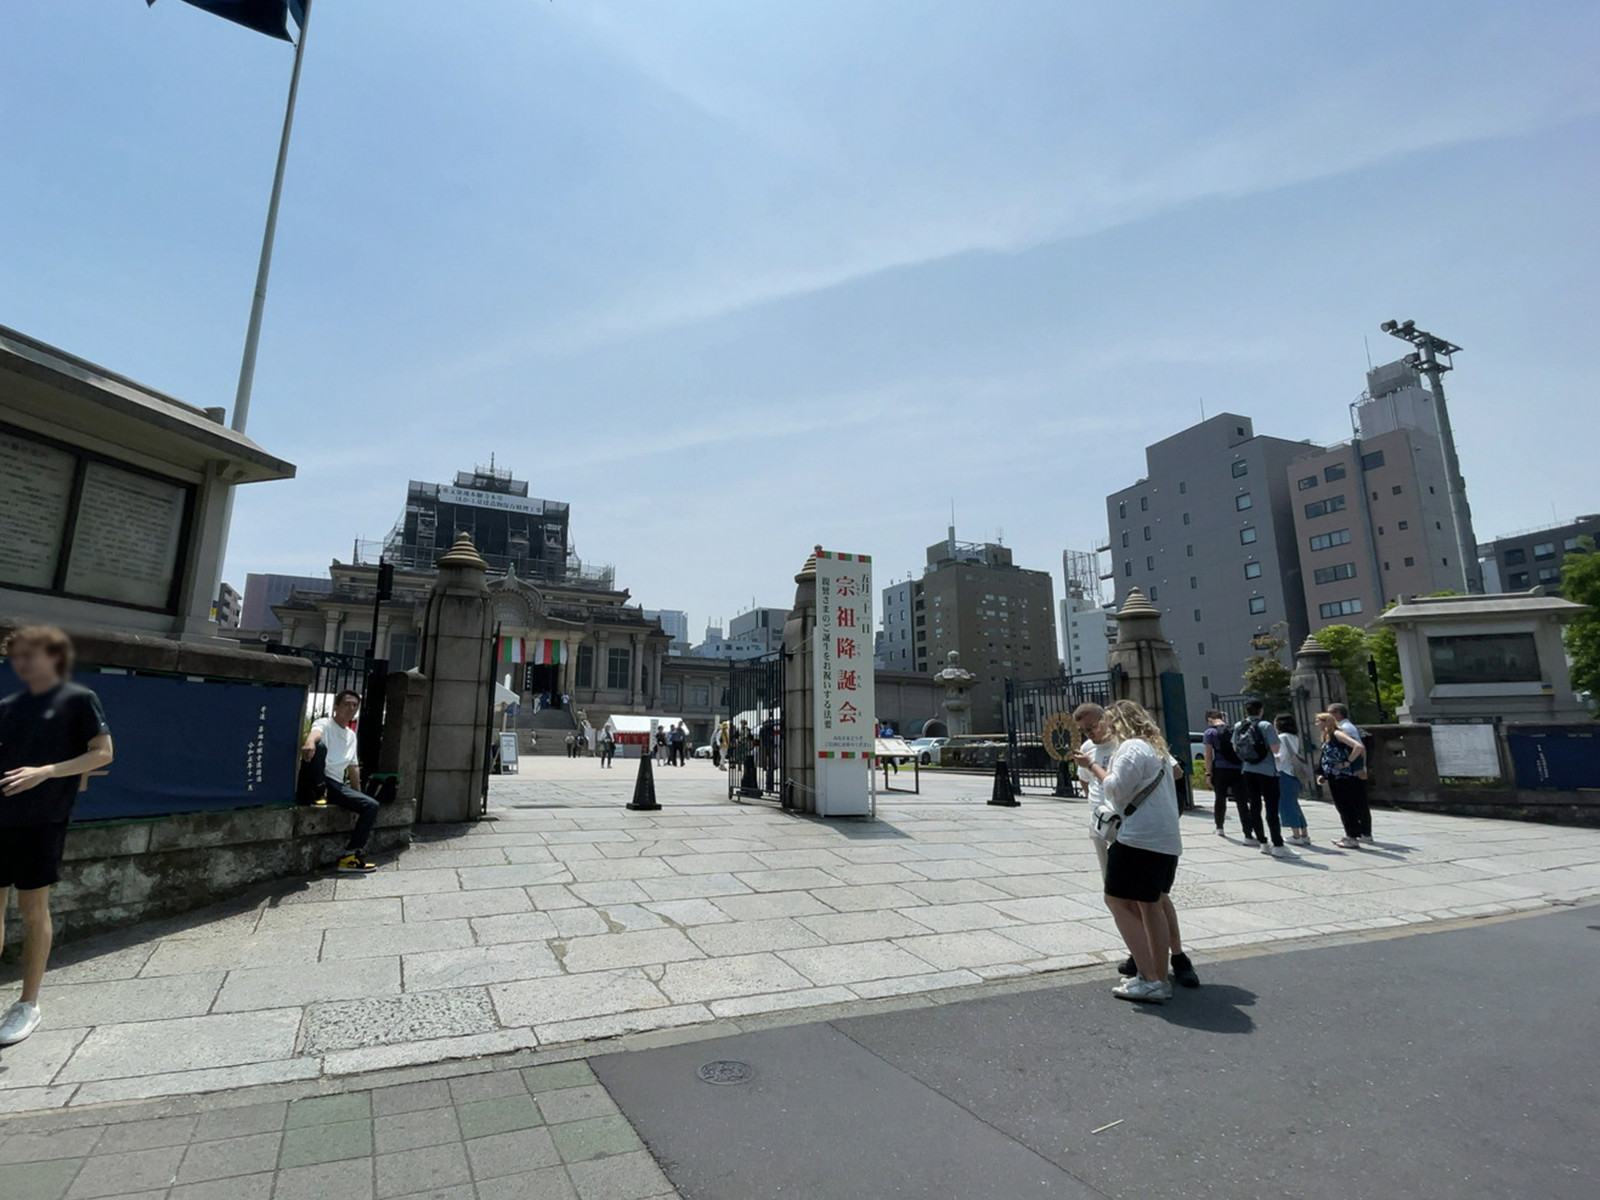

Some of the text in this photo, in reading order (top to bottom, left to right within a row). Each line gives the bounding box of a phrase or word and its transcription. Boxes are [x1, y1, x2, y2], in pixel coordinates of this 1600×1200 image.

[821, 577, 832, 729] 親鸞さまのご誕生をお祝いする法要
[835, 575, 857, 724] 宗祖降誕会
[860, 574, 871, 634] 五月二十一日
